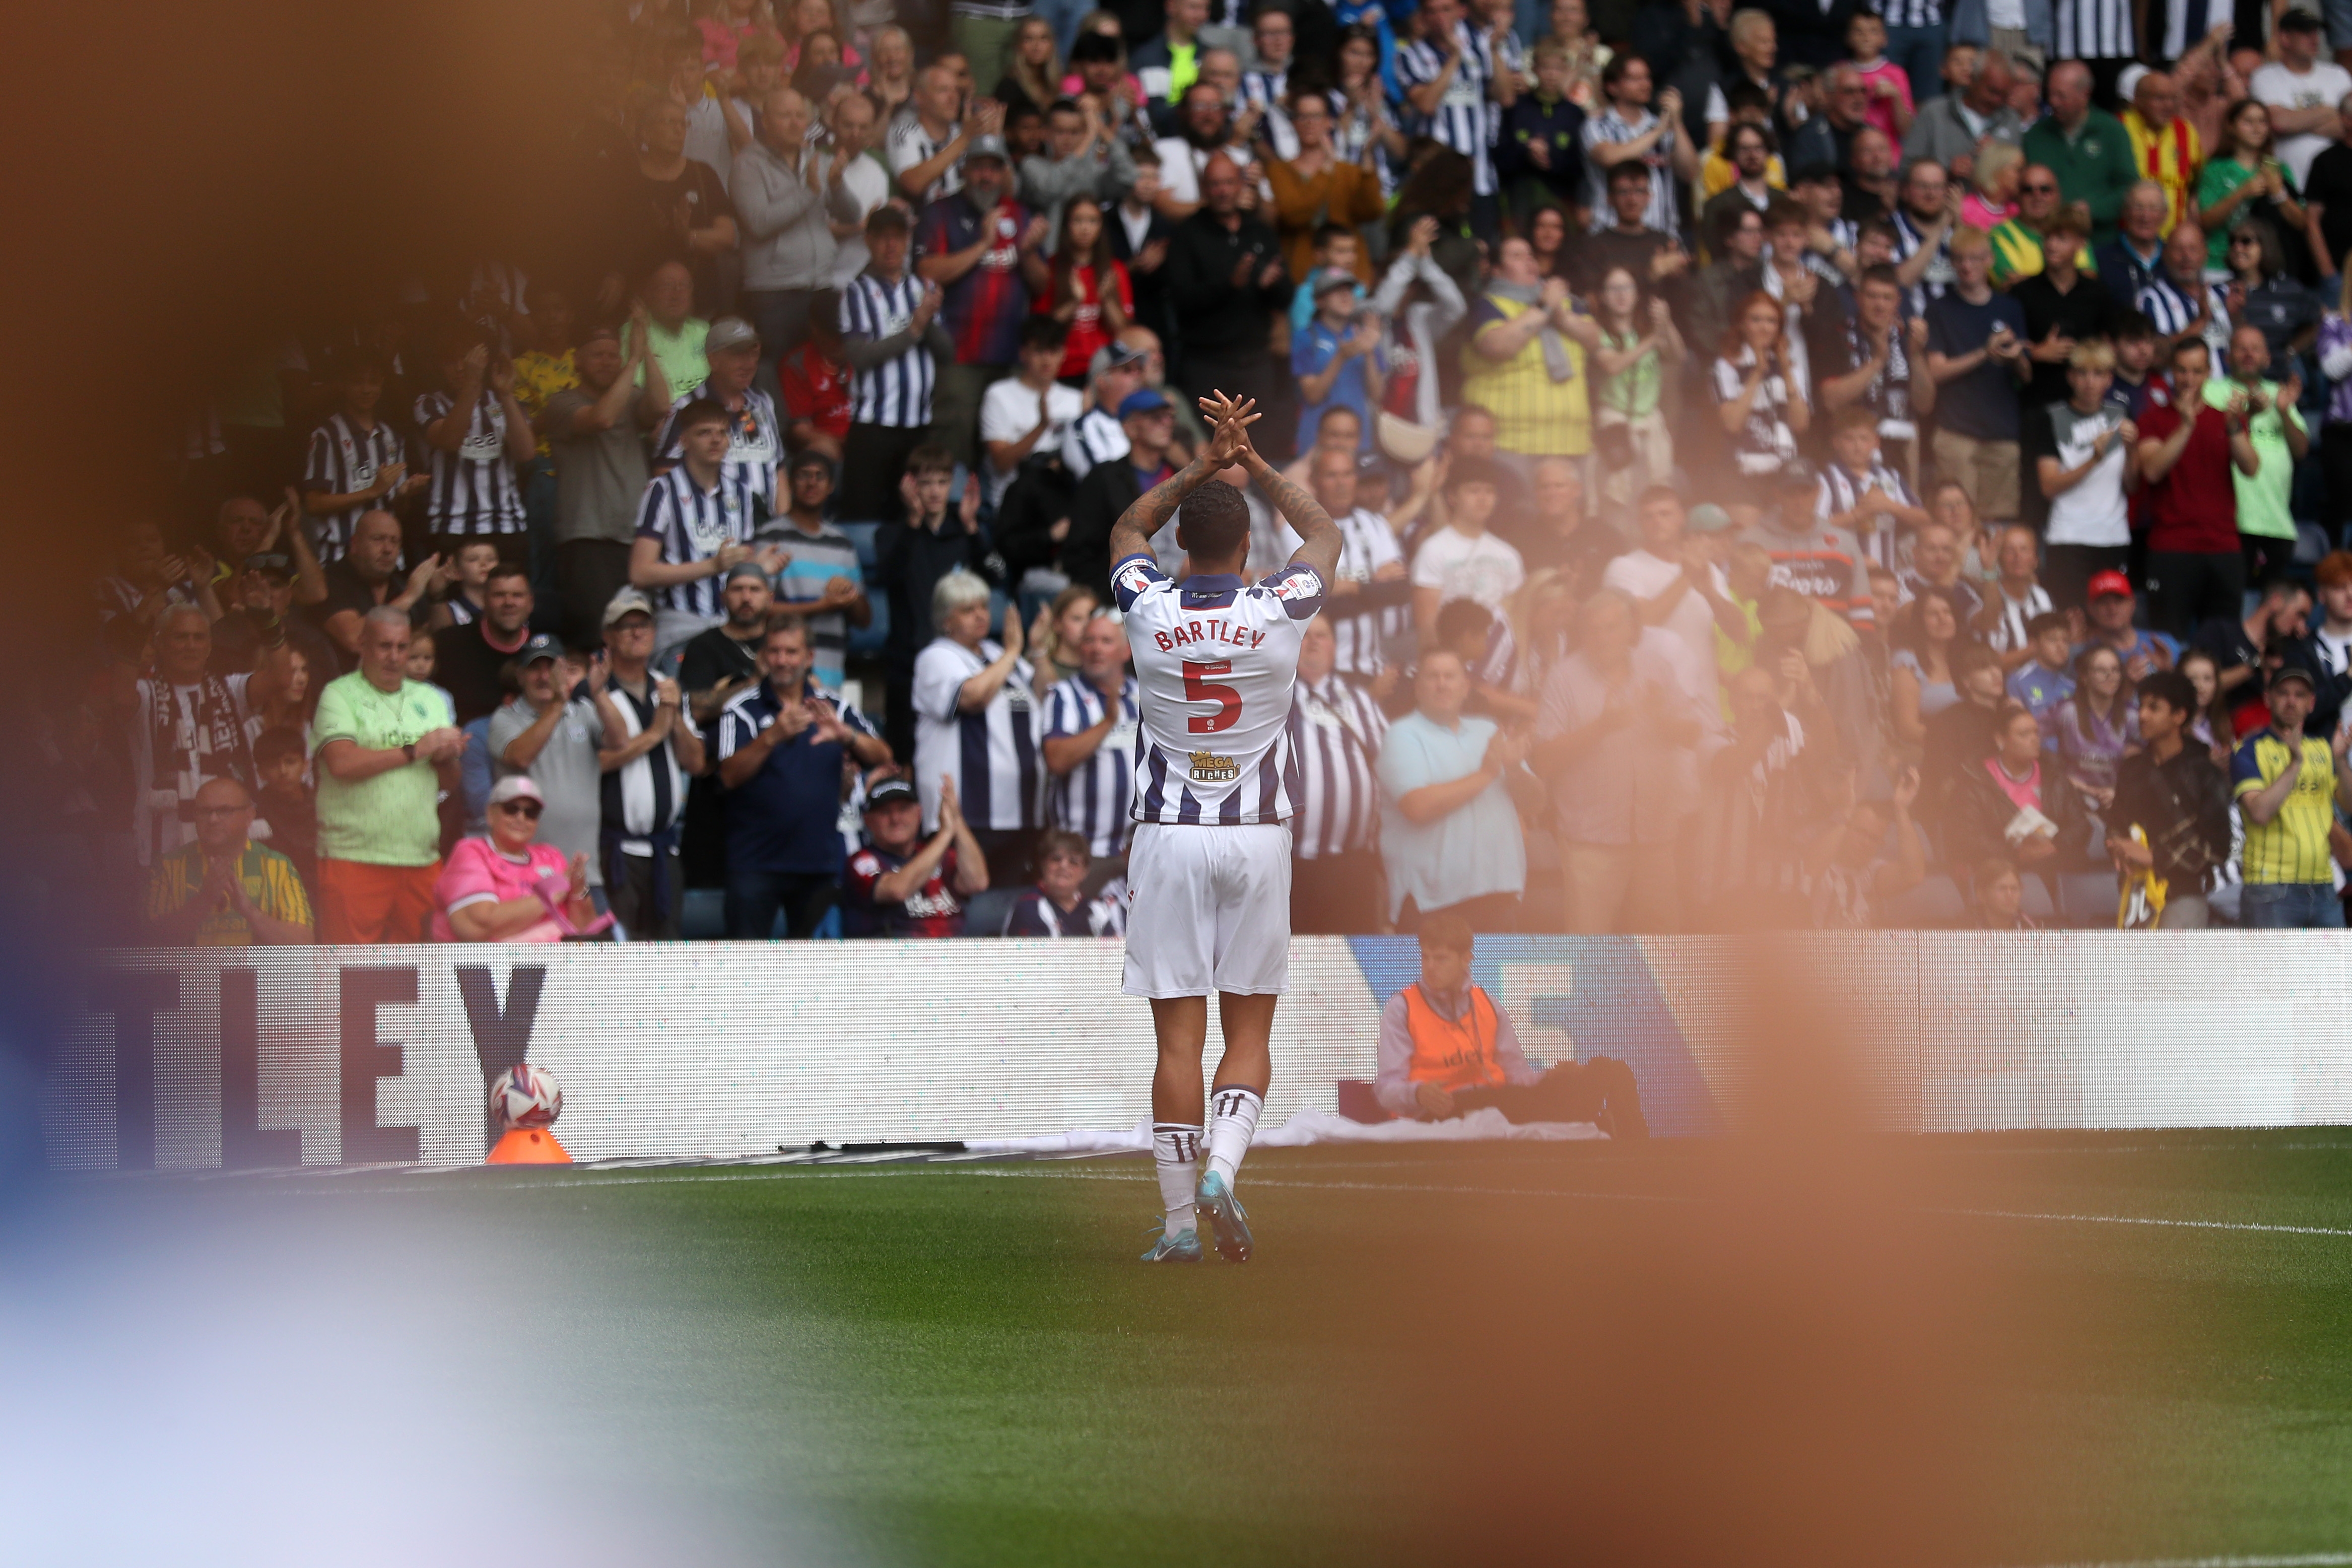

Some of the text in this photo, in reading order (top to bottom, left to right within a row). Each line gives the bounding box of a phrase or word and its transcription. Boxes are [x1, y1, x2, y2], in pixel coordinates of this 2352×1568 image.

[1112, 562, 1132, 582] CAPTAIN
[1154, 620, 1266, 652] BARTLEY
[1182, 659, 1243, 734] 5
[1194, 757, 1234, 768] MEGA
[1193, 770, 1234, 780] RICHES
